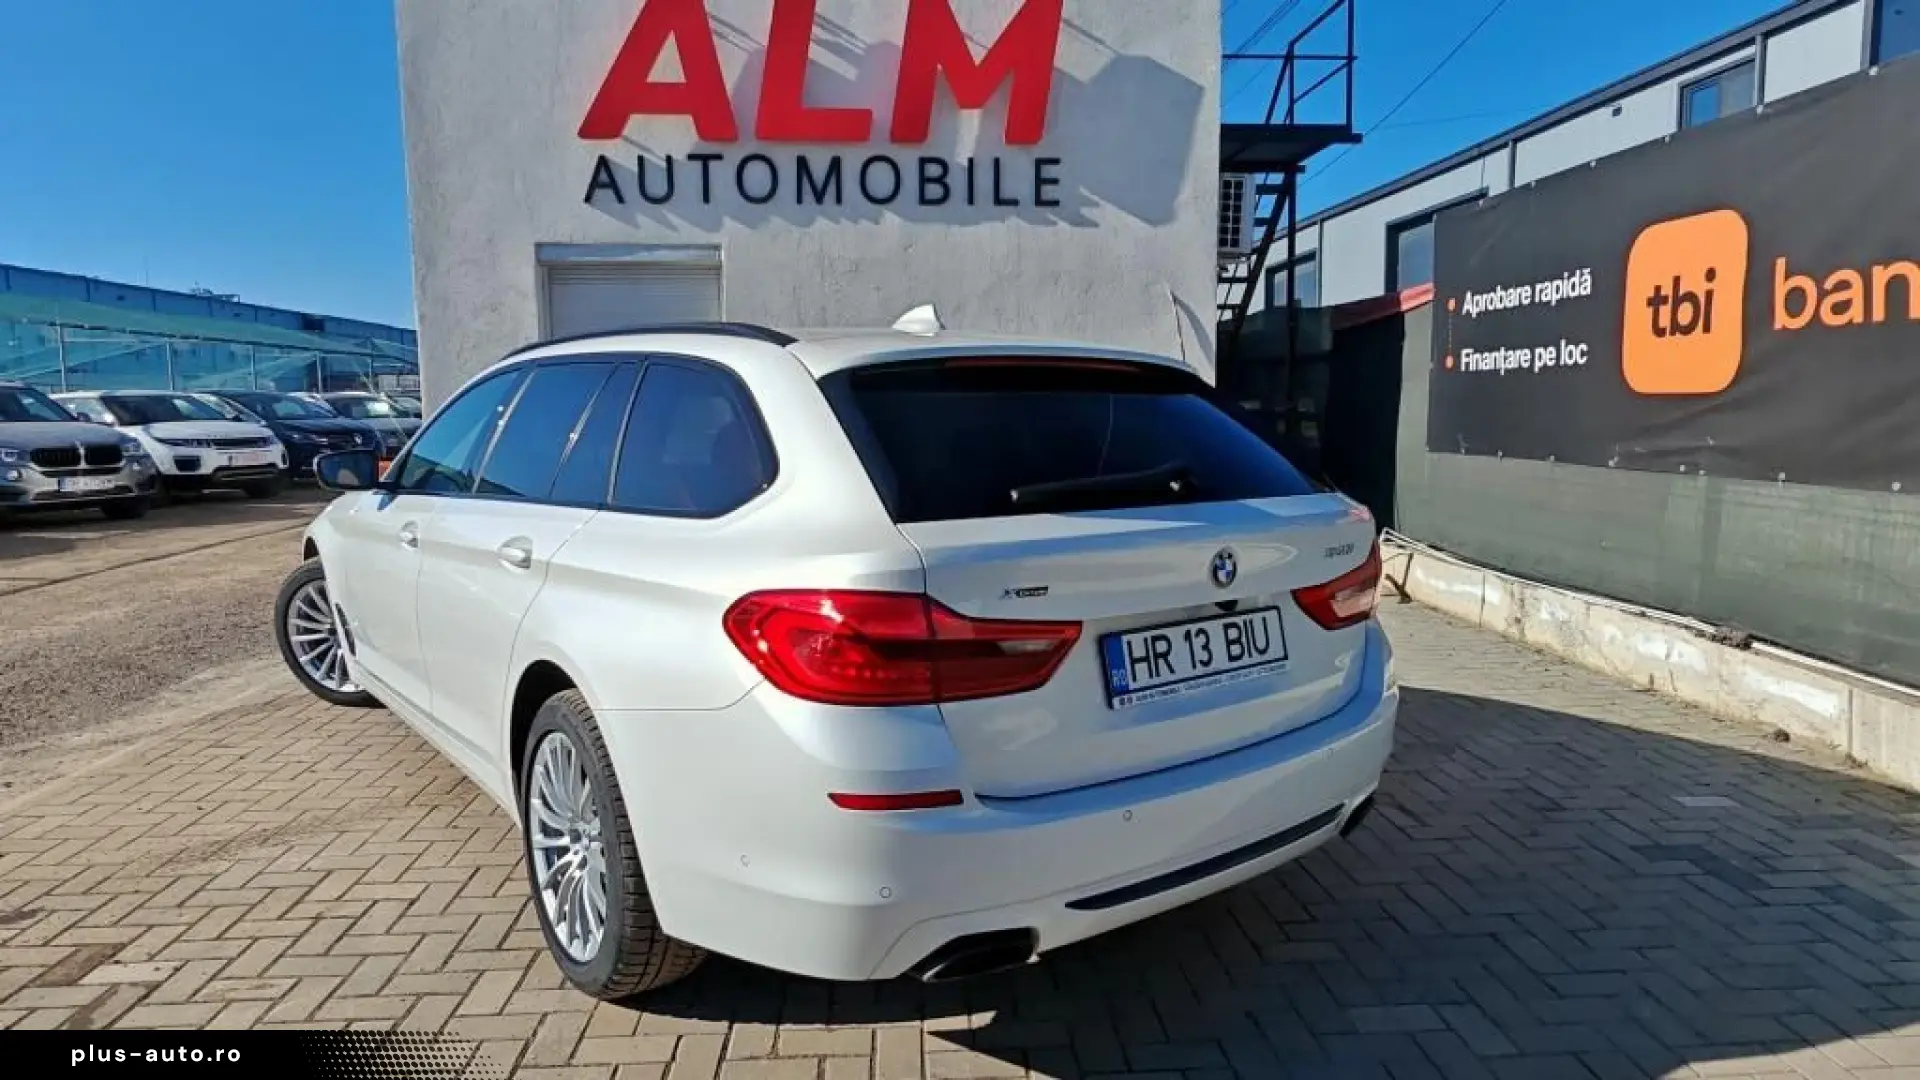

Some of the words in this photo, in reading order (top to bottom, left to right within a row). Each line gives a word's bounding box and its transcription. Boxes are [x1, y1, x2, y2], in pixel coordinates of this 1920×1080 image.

[578, 0, 1064, 145] ALM
[584, 153, 1062, 208] AUTOMOBILE
[1462, 285, 1531, 318] Aprobare
[1534, 267, 1592, 306] rapidă
[1646, 267, 1717, 338] tbi
[1534, 345, 1556, 373] pe
[1560, 339, 1588, 366] loc
[1127, 634, 1175, 682] HR
[1184, 628, 1214, 670] 13
[1223, 617, 1270, 662] BIU
